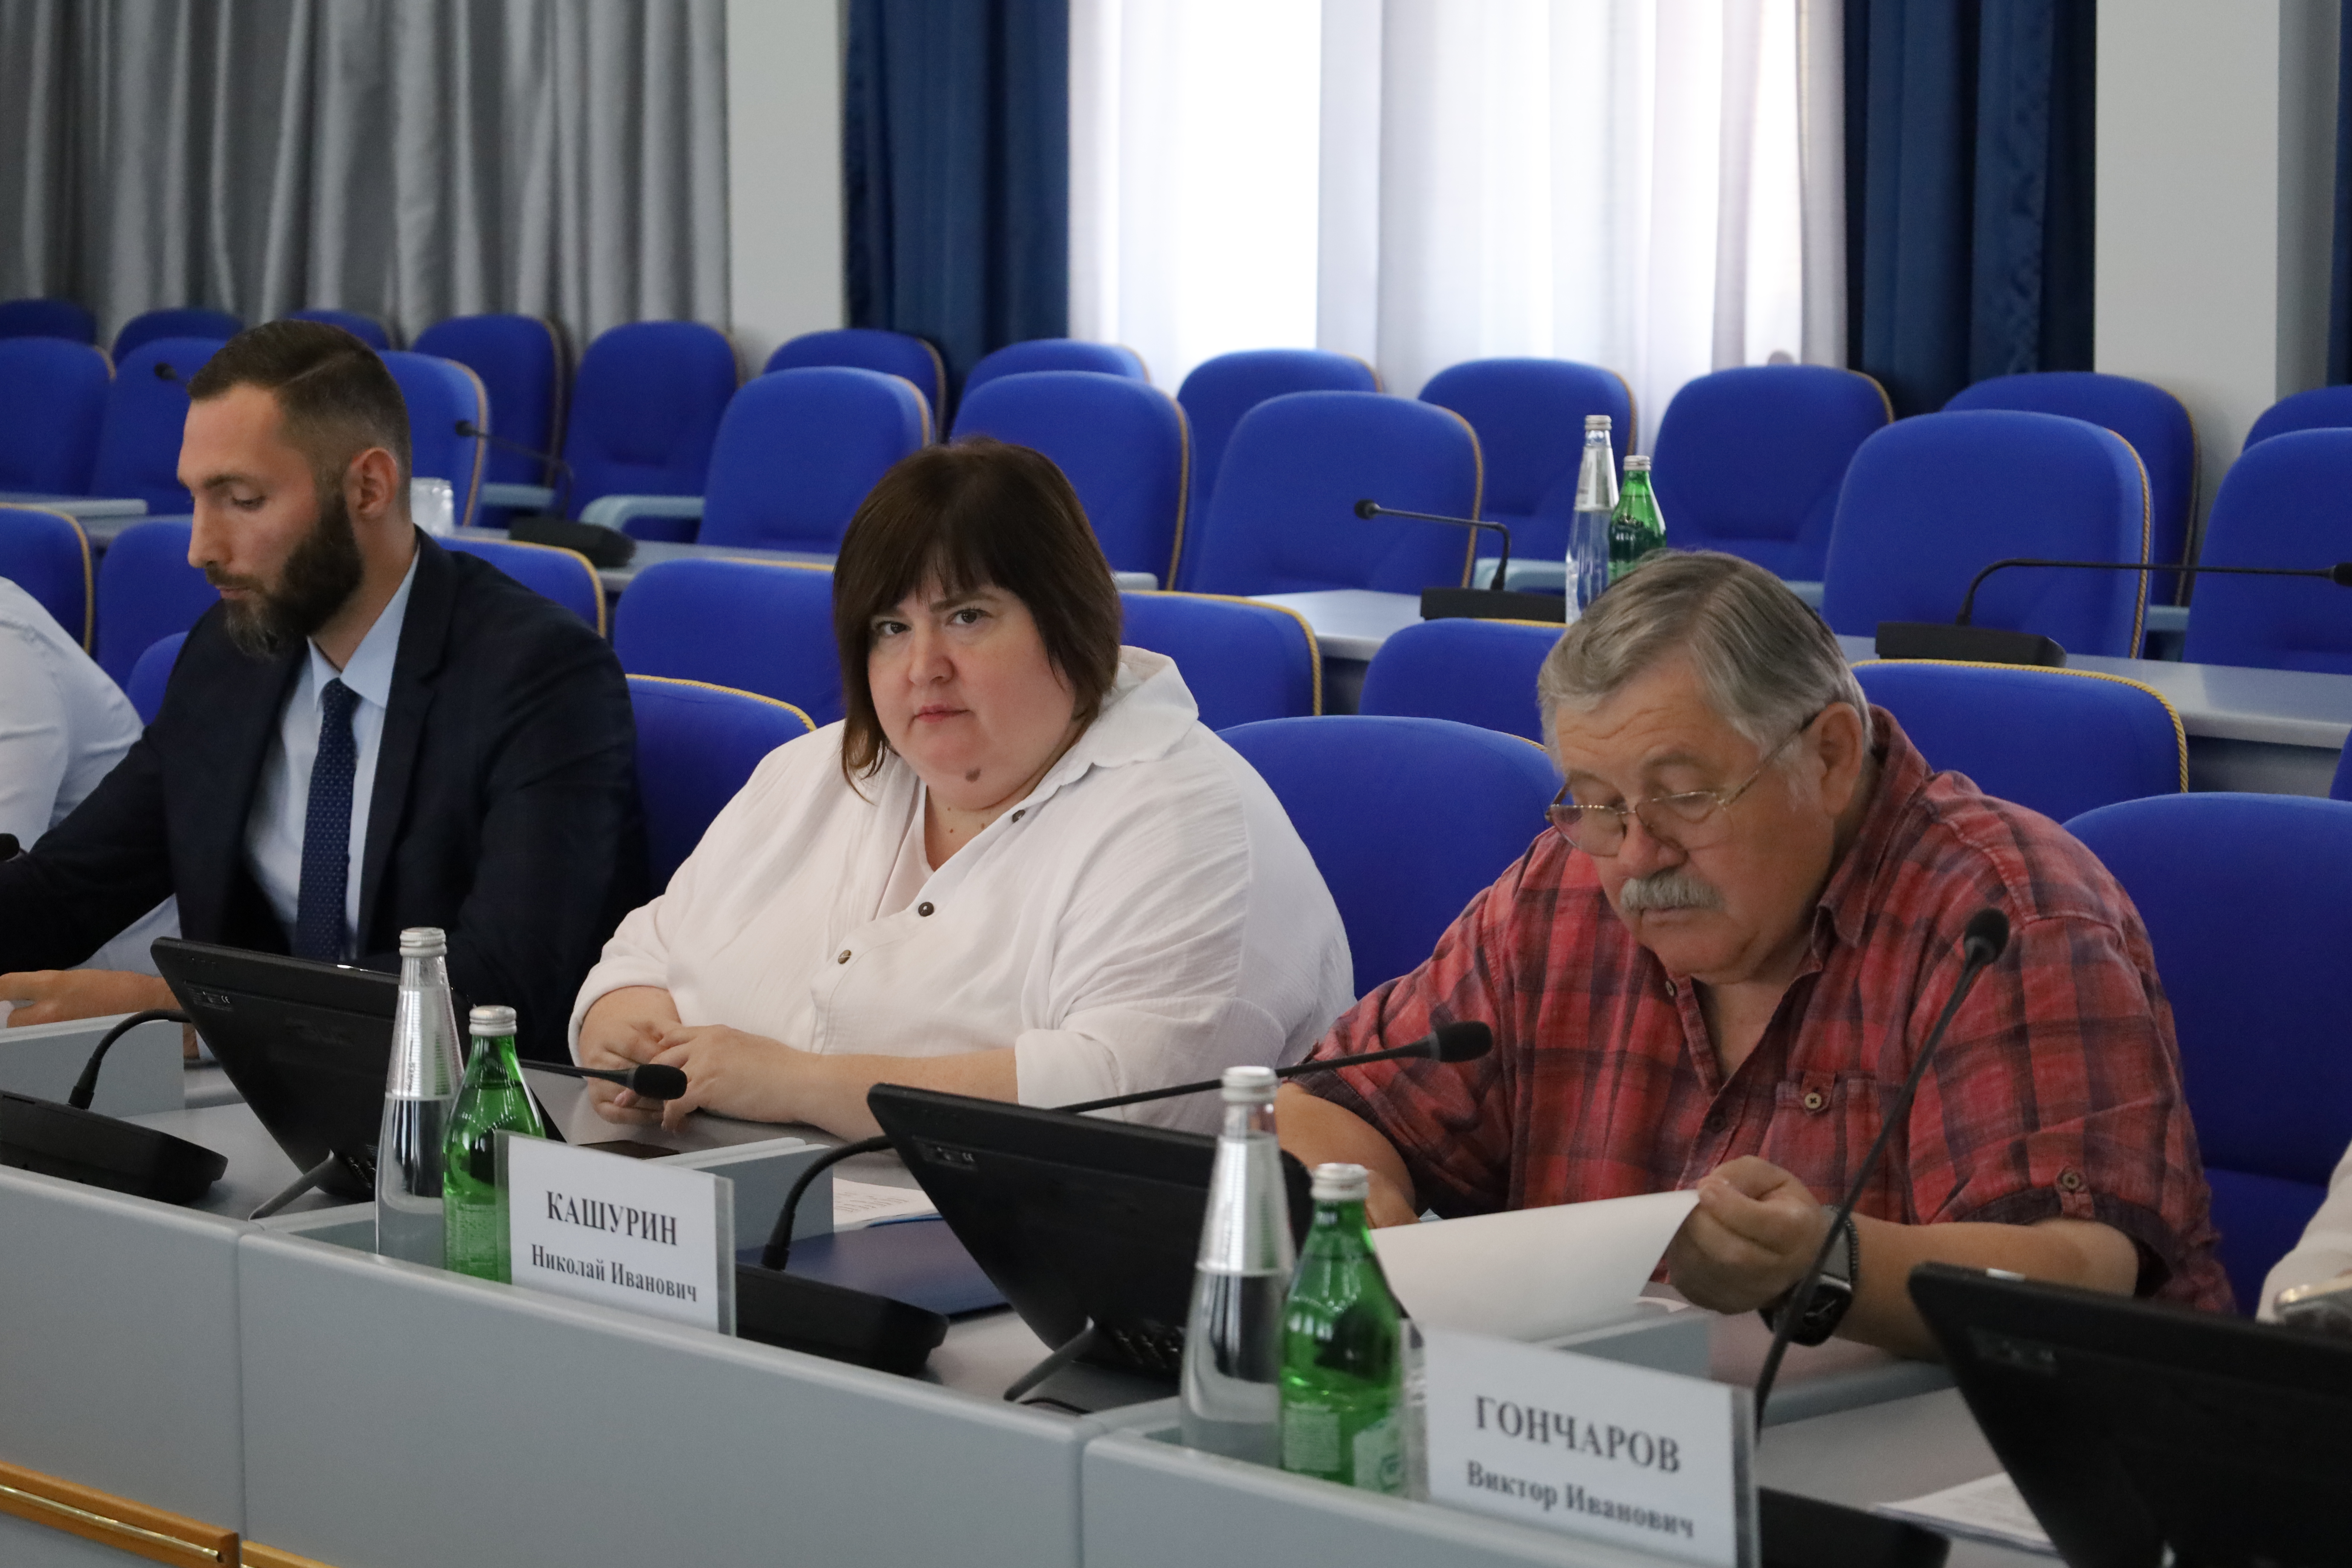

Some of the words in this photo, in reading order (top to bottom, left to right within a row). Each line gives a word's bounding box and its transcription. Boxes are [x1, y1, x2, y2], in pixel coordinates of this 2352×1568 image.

[546, 1190, 677, 1246] КАШУРИН
[531, 1244, 605, 1282] Николай
[611, 1261, 697, 1302] Иванович
[1476, 1395, 1681, 1473] ГОНЧАРОВ
[1467, 1459, 1558, 1512] Виктор
[1566, 1483, 1694, 1539] Иванович
